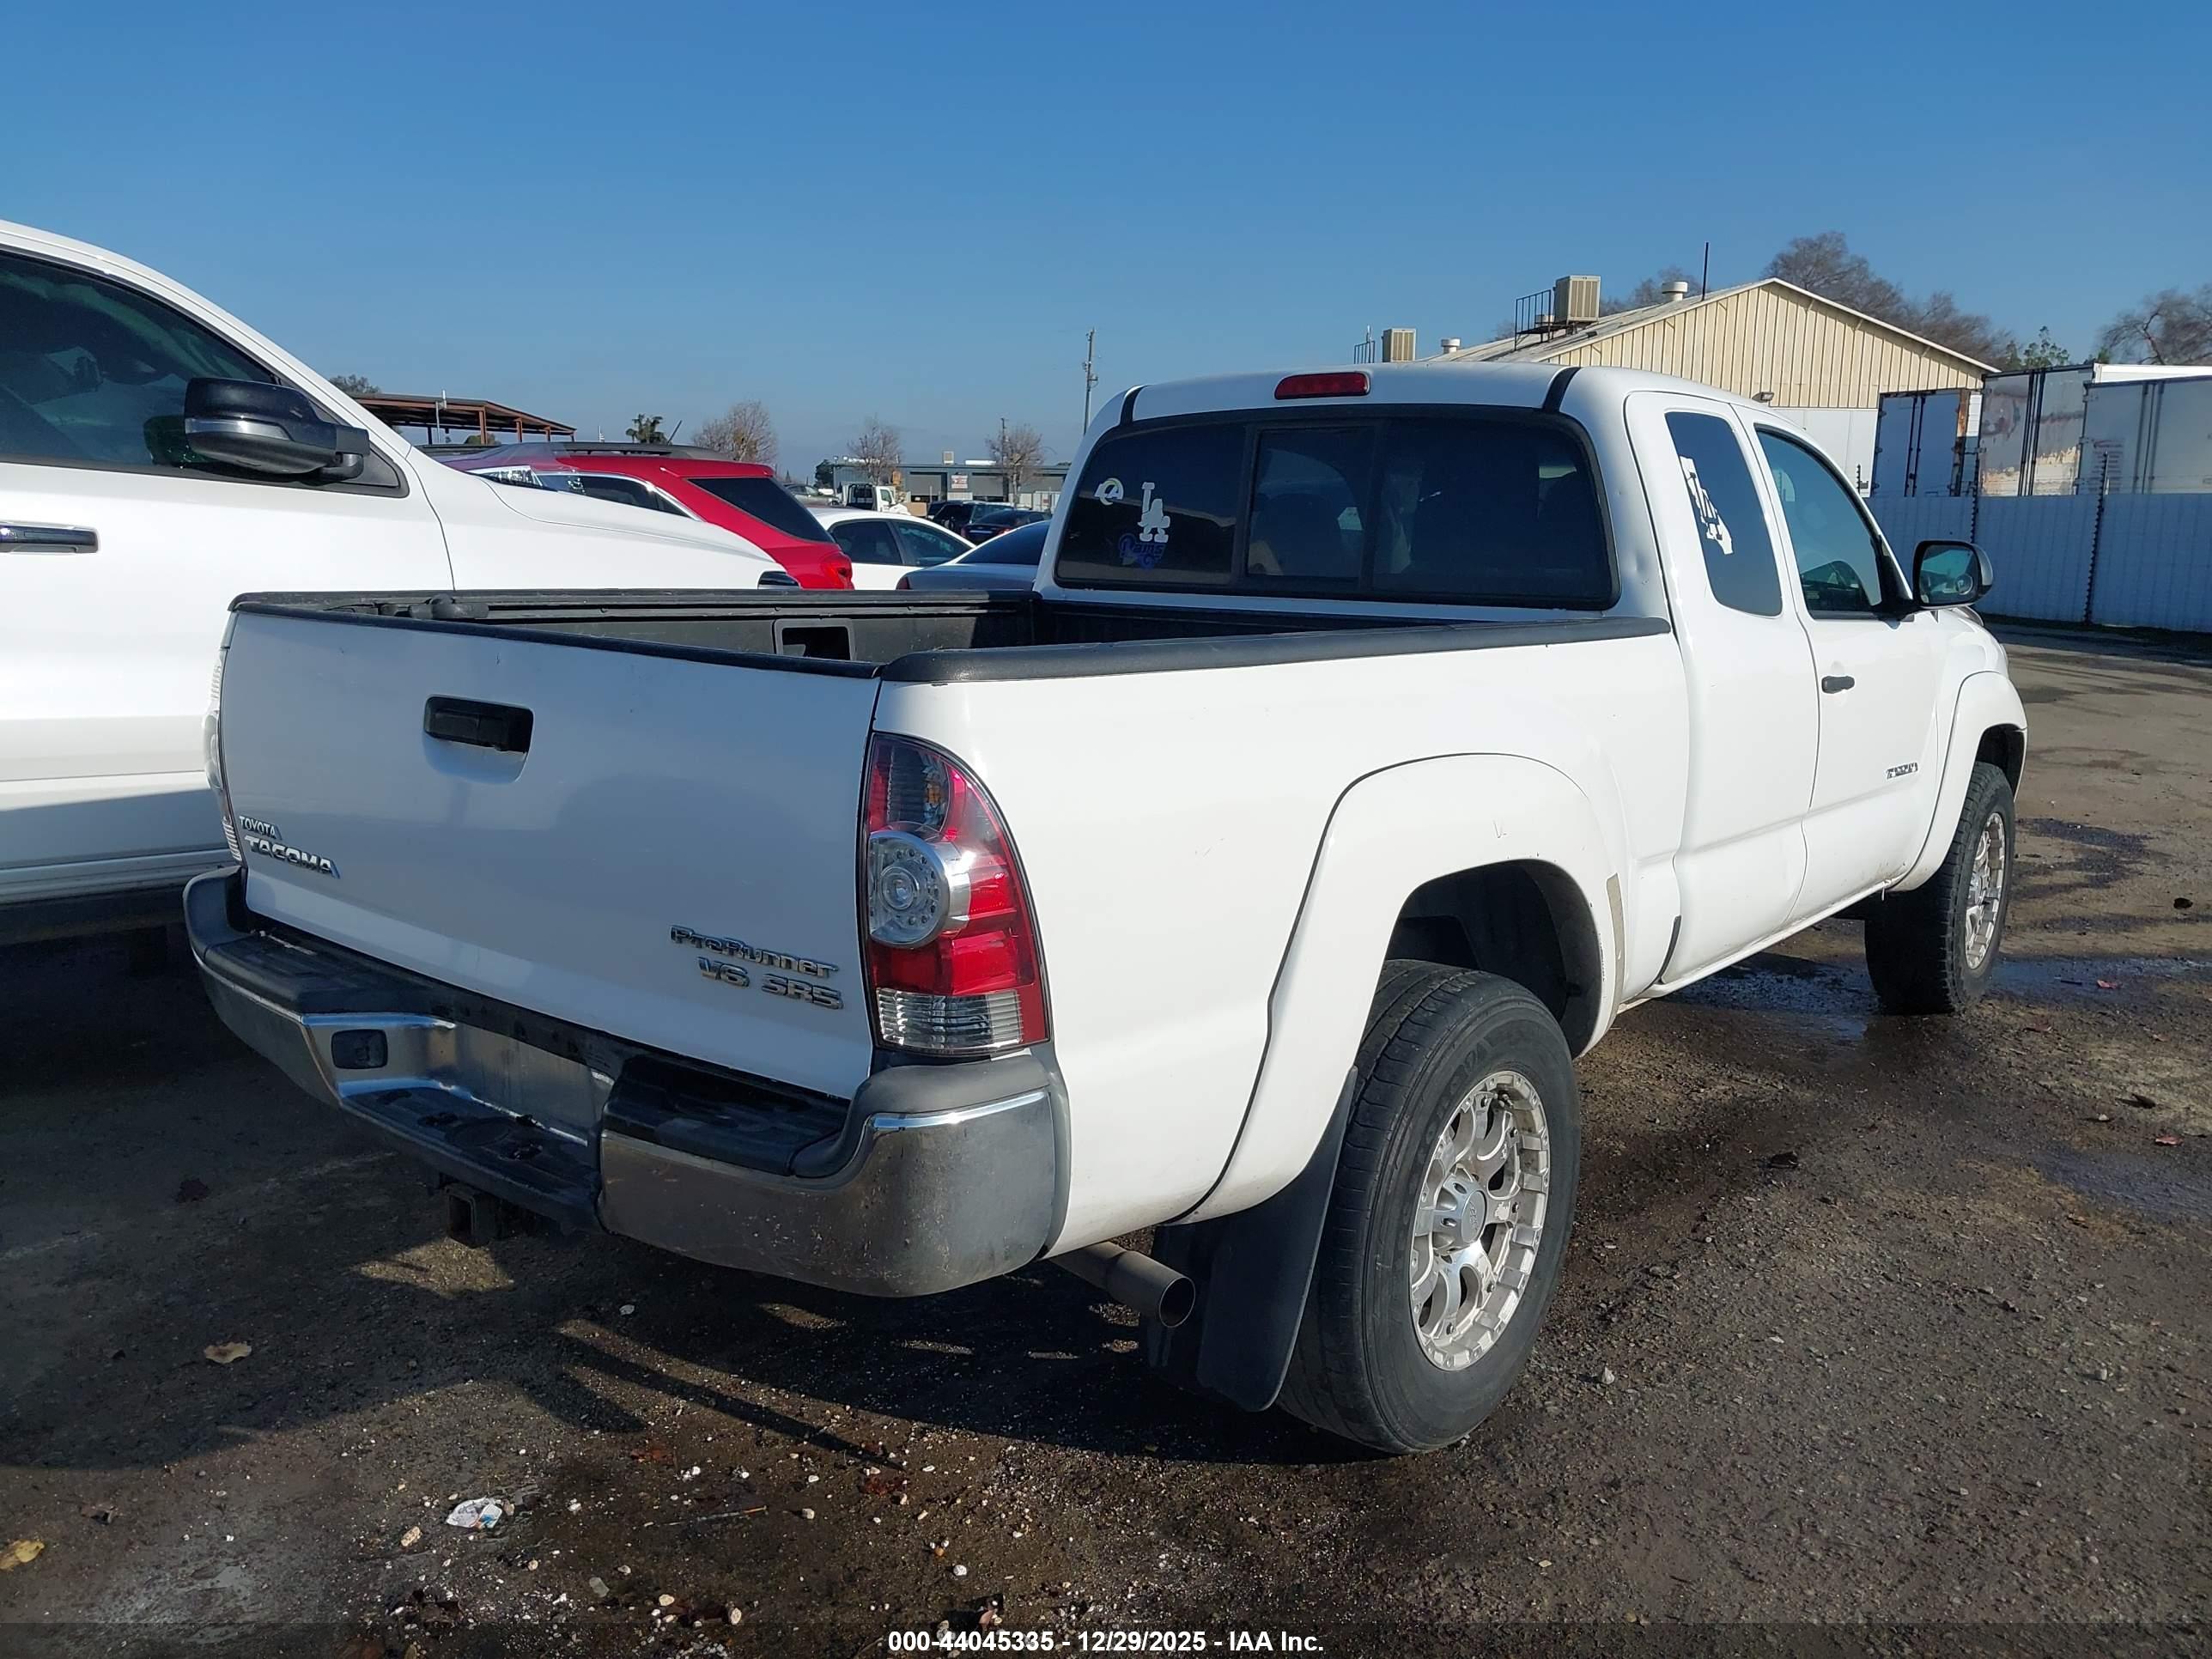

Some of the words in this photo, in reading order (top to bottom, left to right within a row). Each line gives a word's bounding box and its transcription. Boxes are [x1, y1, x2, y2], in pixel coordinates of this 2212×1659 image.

[239, 815, 277, 839] TOYOTA
[245, 835, 336, 875] TACOMA
[696, 957, 750, 987] V6
